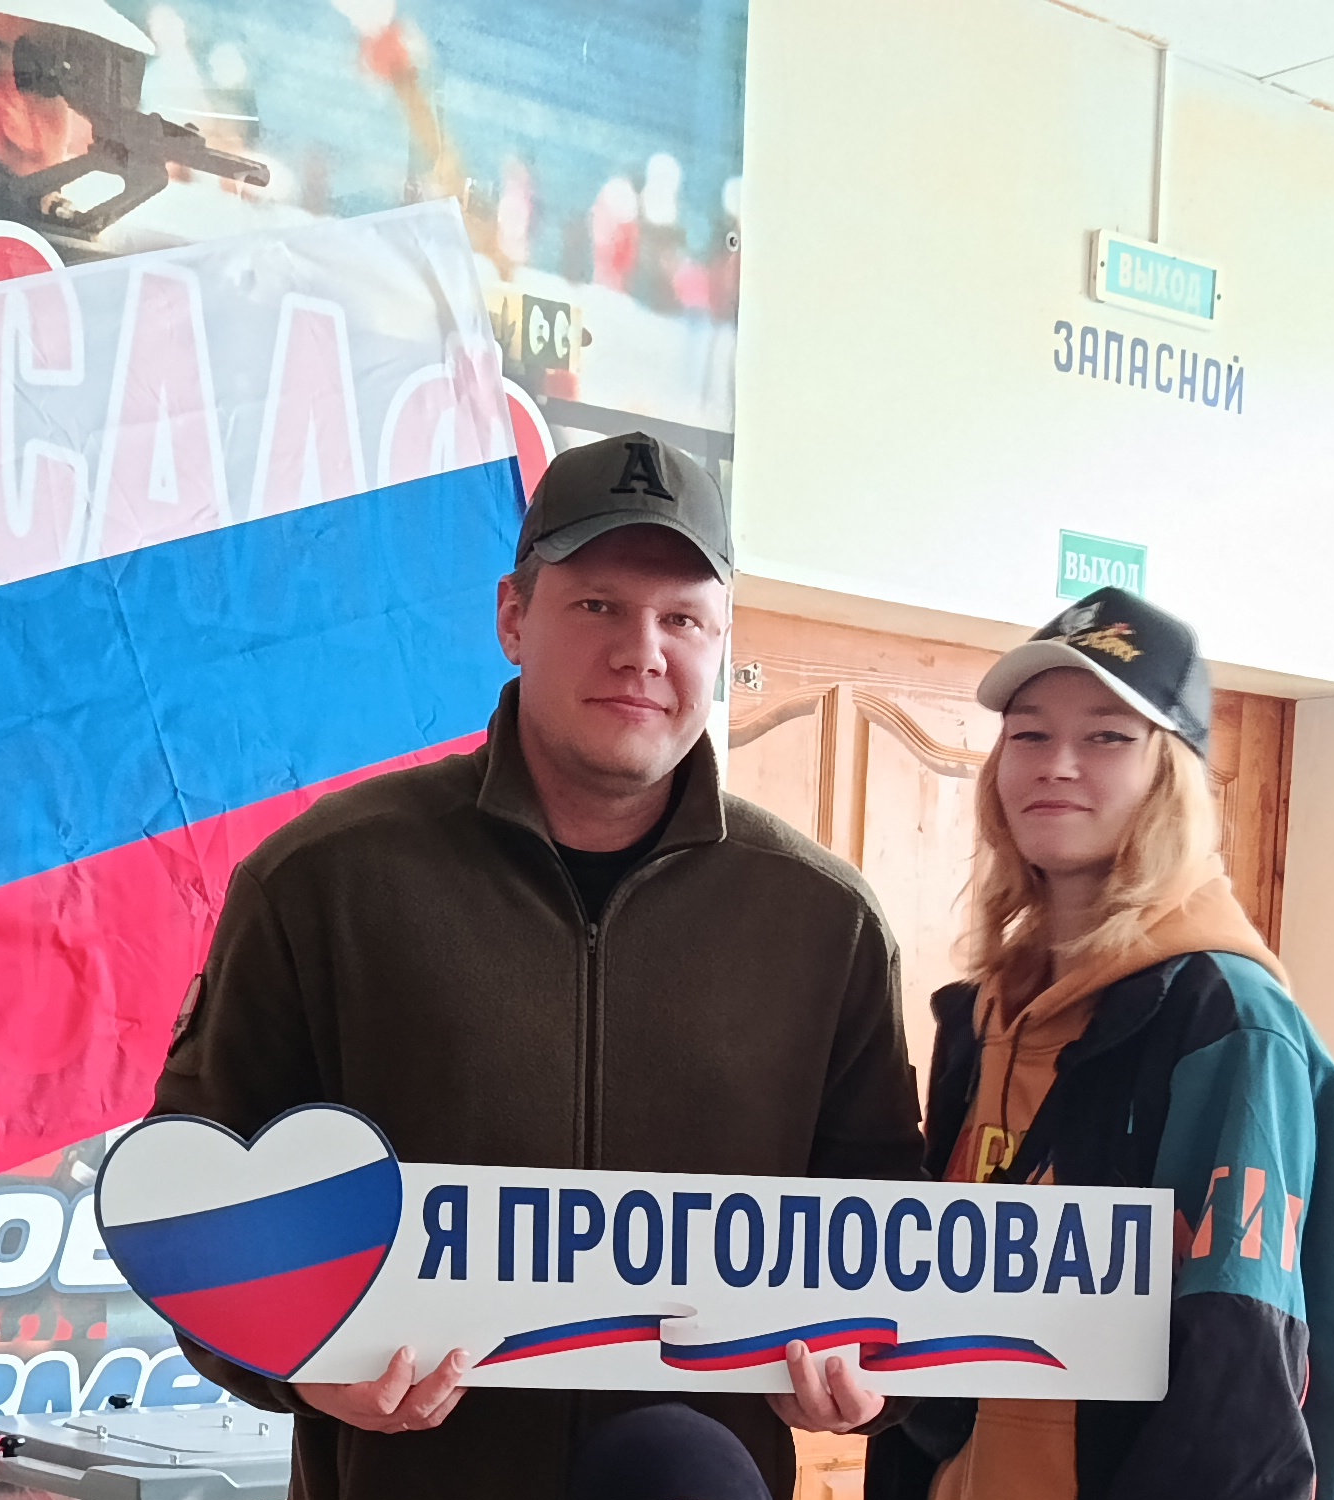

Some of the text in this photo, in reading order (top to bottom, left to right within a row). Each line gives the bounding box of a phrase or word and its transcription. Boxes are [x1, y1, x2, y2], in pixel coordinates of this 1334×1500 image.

[1119, 252, 1202, 315] ВЫХОД
[1054, 320, 1244, 414] ЗАПАСНОЙ
[1064, 550, 1141, 595] ВЫХОД
[418, 1184, 469, 1282] Я
[497, 1186, 1153, 1296] ПРОГОЛОСОВАЛ
